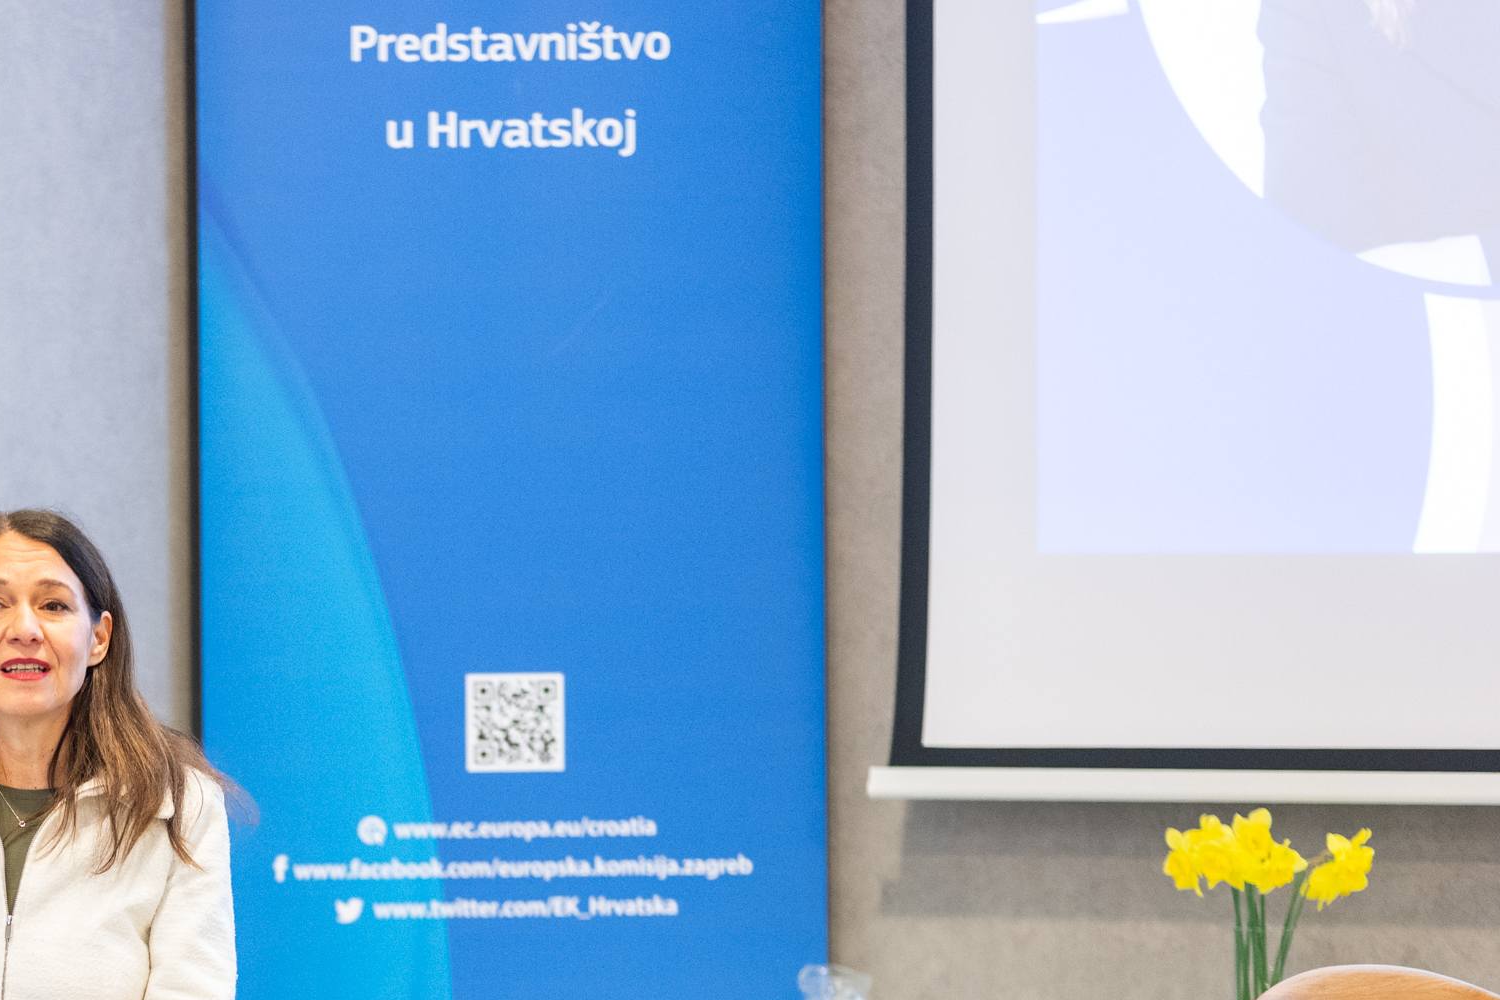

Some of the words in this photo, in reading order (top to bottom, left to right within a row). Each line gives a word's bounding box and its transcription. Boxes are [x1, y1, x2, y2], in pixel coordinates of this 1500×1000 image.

[350, 21, 671, 62] Predstavništvo
[386, 120, 414, 149] u
[428, 107, 636, 157] Hrvatskoj
[394, 816, 657, 841] www.ec.europa.eu/croatia
[293, 854, 753, 881] www.facebook.com/europska.komisija.zagreb
[373, 895, 678, 920] www.twitter.com/EK_Hrvatska
